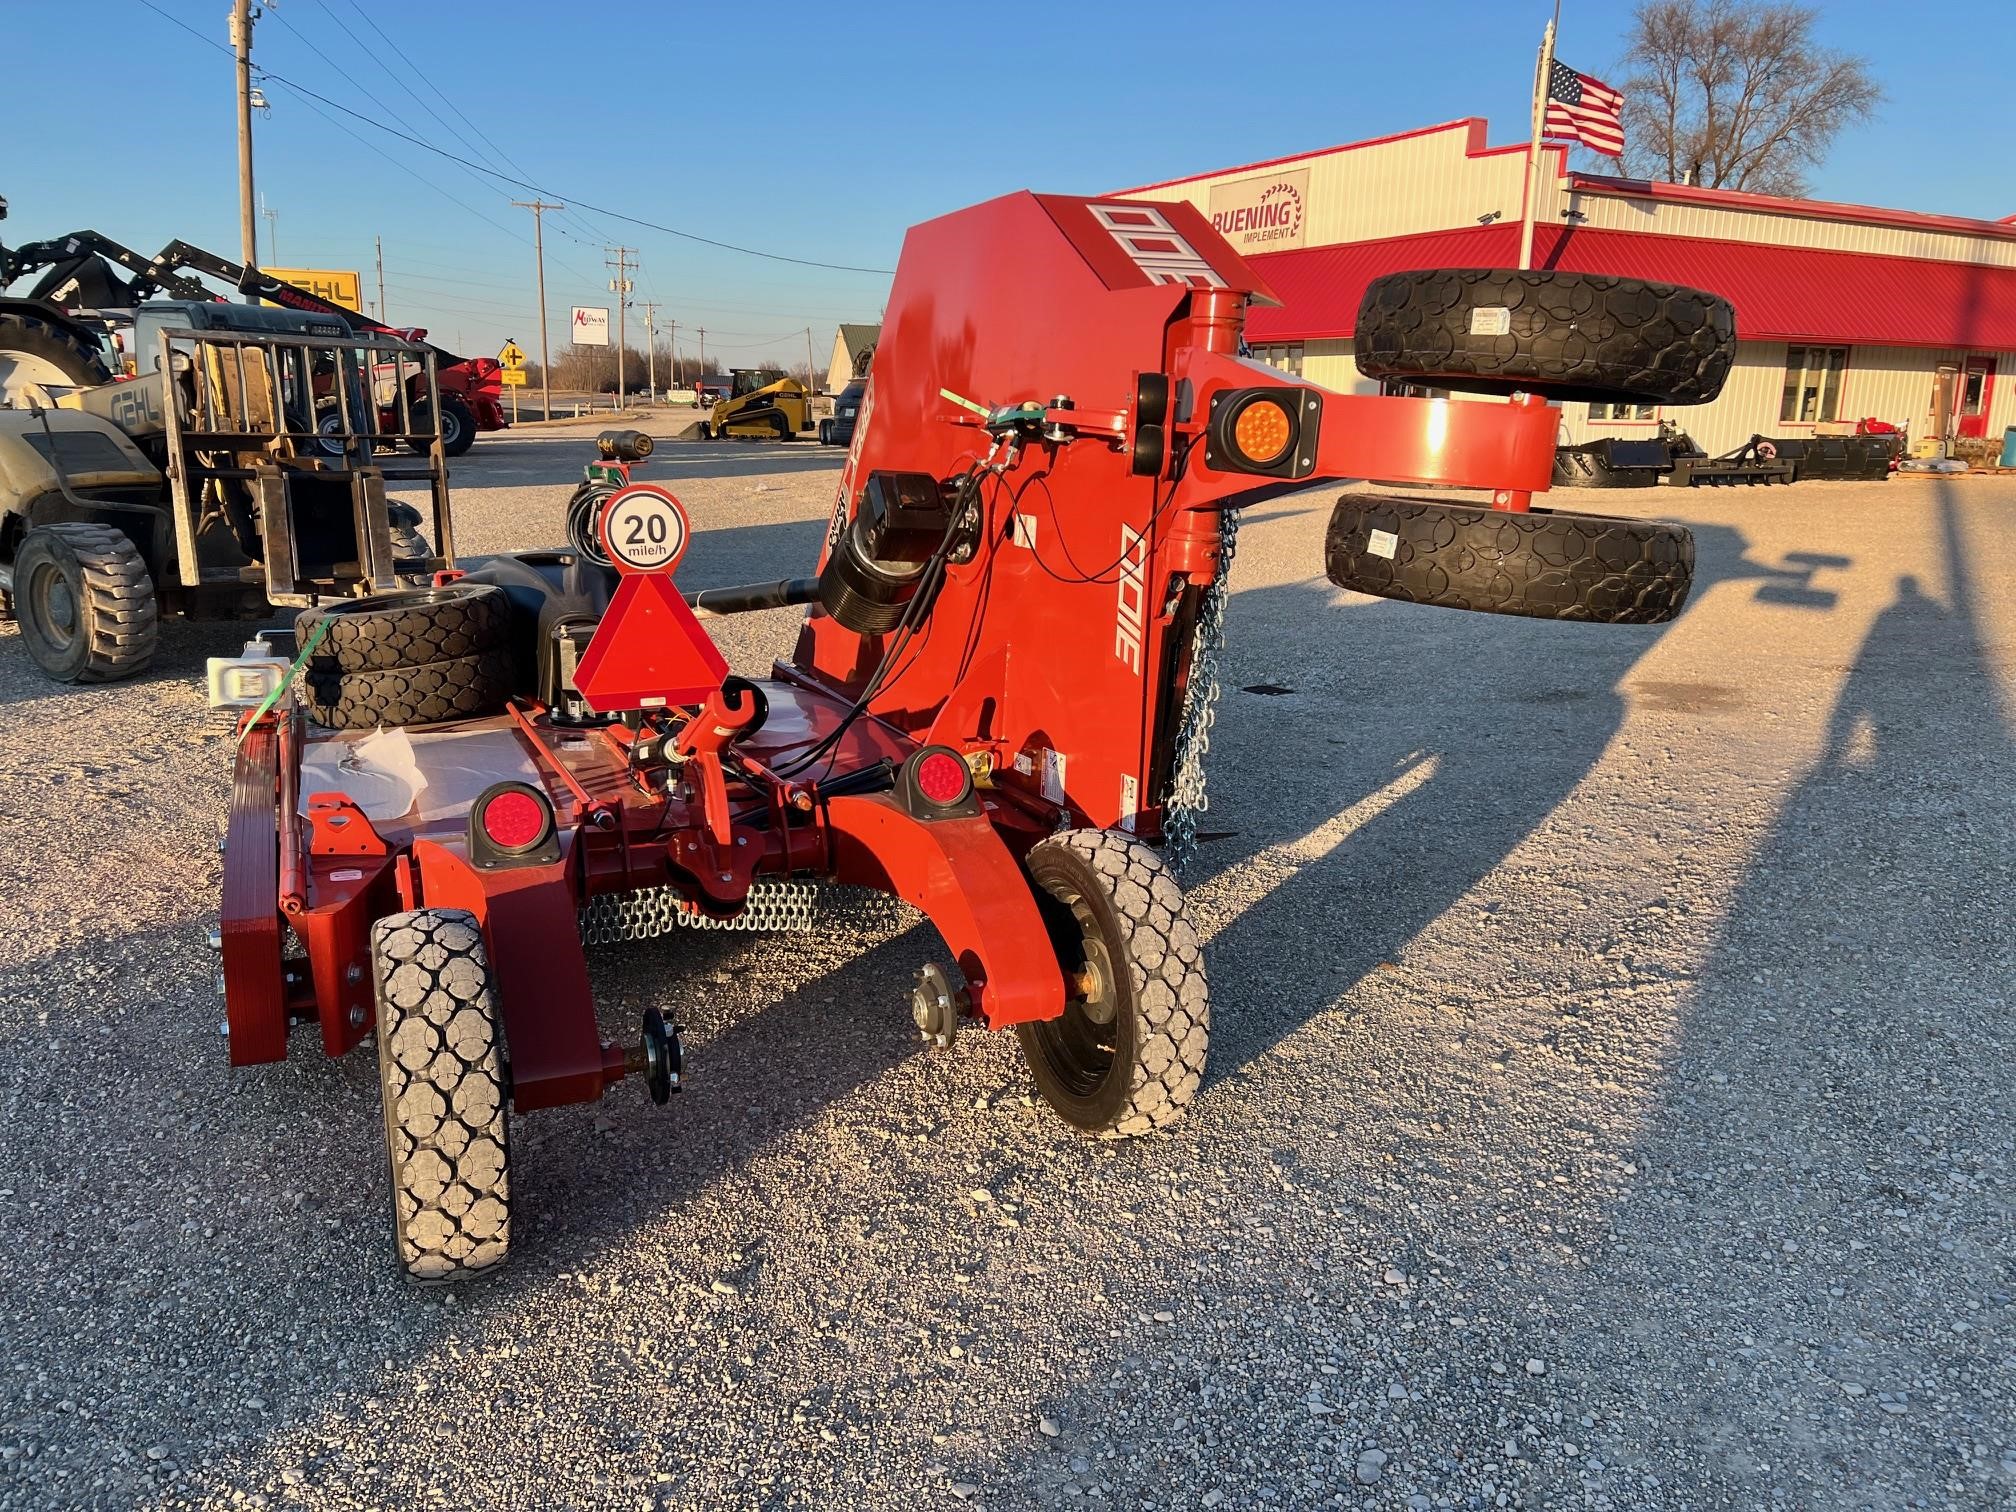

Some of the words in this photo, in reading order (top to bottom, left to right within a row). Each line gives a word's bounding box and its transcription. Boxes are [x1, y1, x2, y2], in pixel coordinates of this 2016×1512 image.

[1212, 201, 1292, 234] BUENING
[1243, 228, 1291, 244] IMPLEMENT
[286, 279, 354, 301] EHL
[110, 386, 160, 427] GEHL
[624, 513, 667, 545] 20
[628, 545, 667, 557] mile/h
